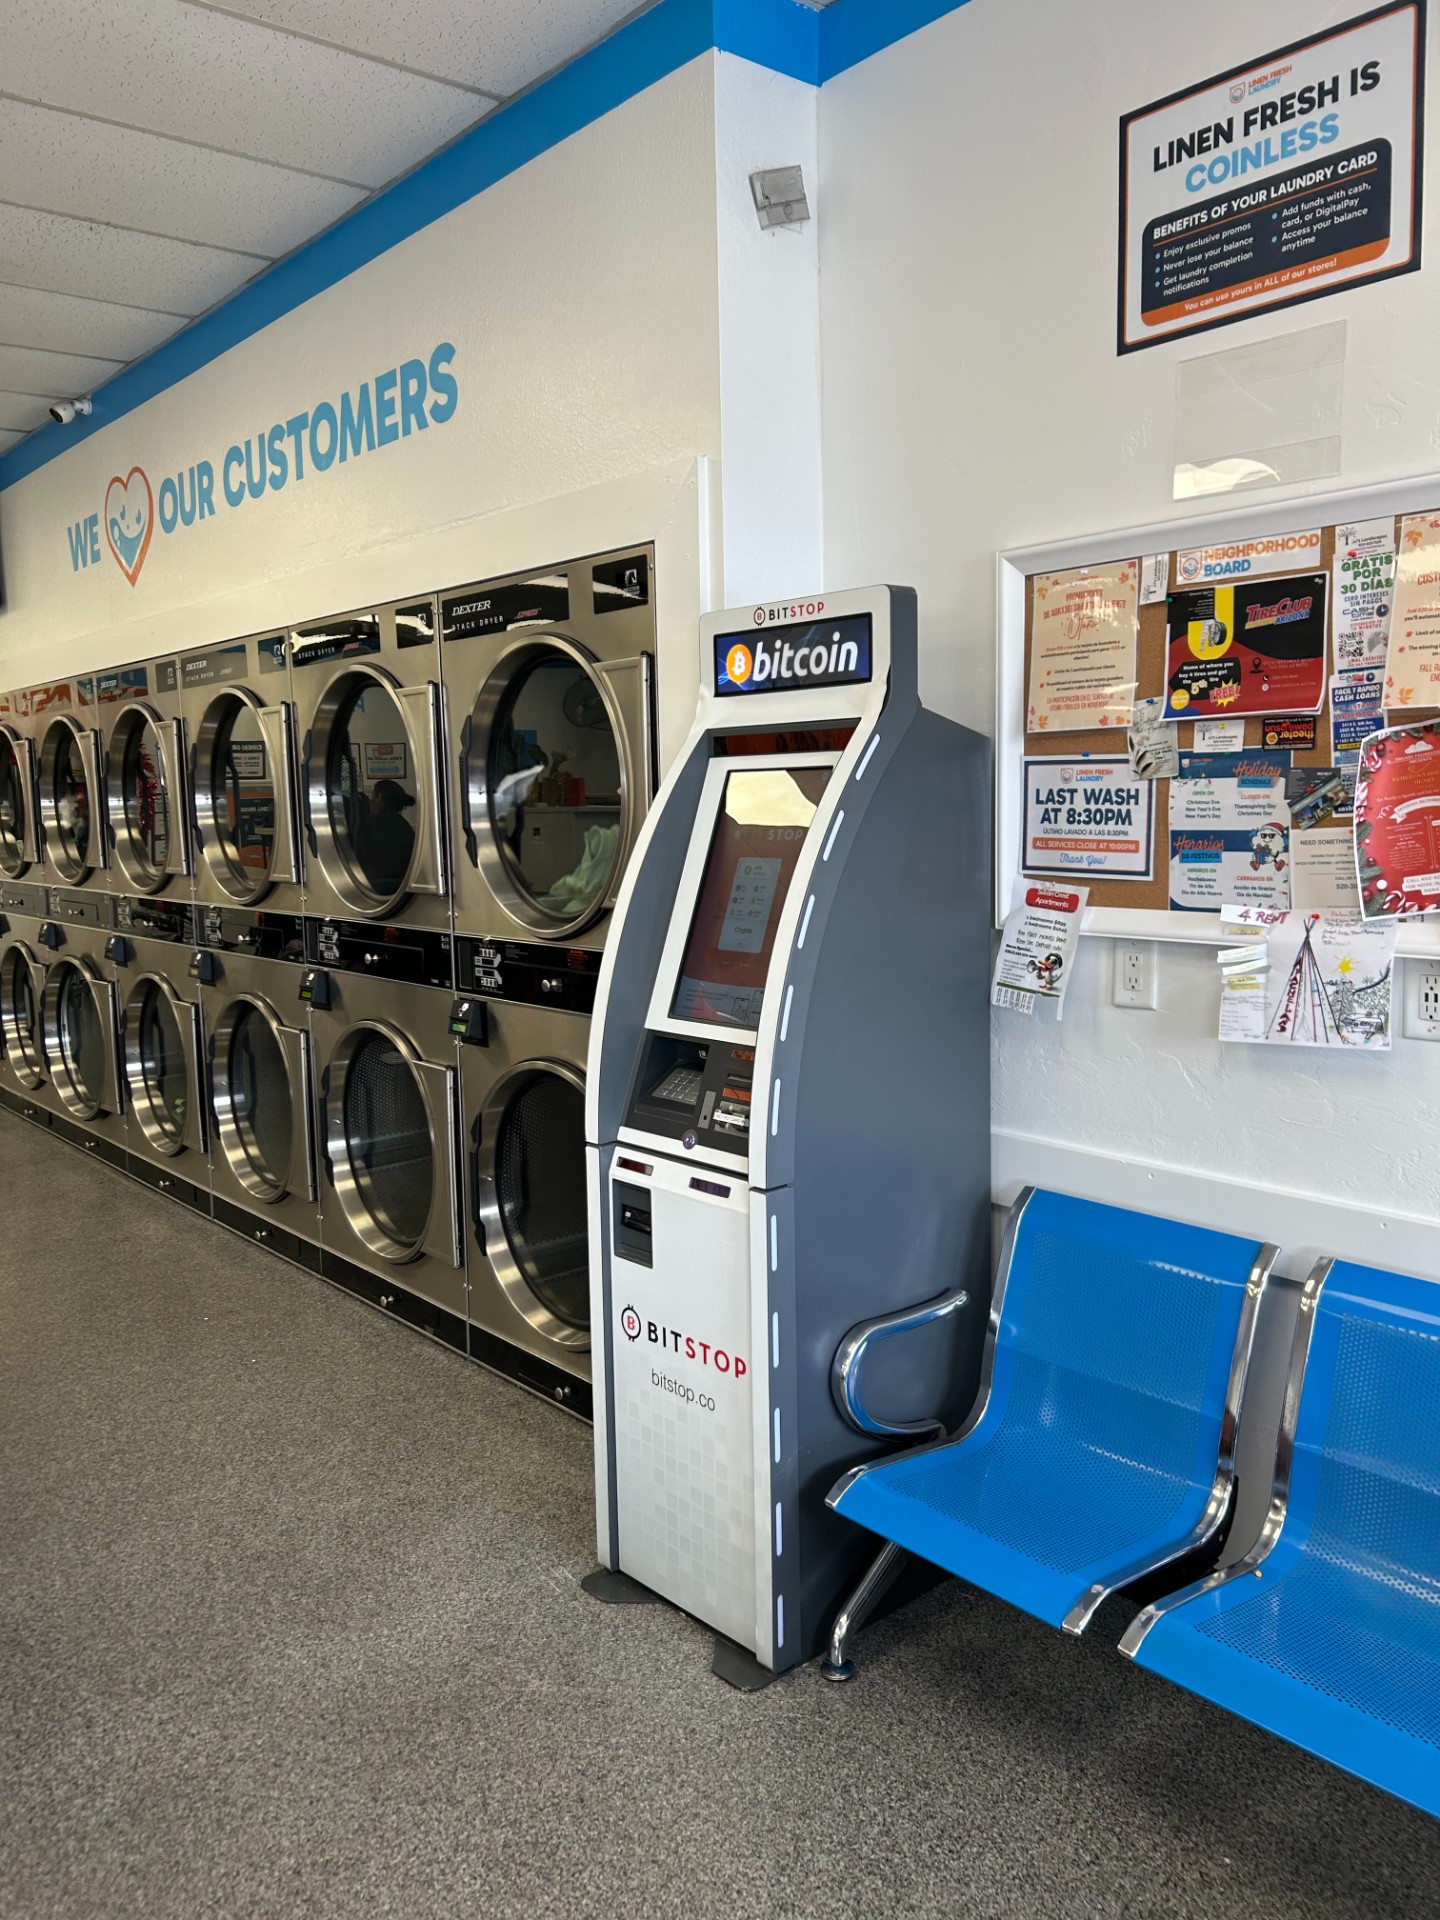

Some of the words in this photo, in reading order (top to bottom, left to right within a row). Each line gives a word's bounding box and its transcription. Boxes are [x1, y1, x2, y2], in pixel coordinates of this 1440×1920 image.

[1248, 73, 1269, 88] LINEN
[1270, 64, 1292, 81] FRESH
[1248, 77, 1281, 95] LAUNDRY
[1153, 117, 1234, 172] LINEN
[1243, 75, 1339, 137] FRESH
[1350, 60, 1380, 96] IS
[1185, 113, 1340, 192] COINLESS
[1153, 210, 1208, 239] BENEFITS
[1211, 203, 1228, 218] OF
[1231, 189, 1267, 212] YOUR
[1270, 165, 1334, 198] LAUNDRY
[1337, 151, 1378, 174] CARD
[1282, 205, 1299, 217] Add
[1301, 197, 1324, 212] funds
[1326, 189, 1346, 202] with
[1347, 182, 1371, 195] cash,
[1281, 216, 1302, 228] card,
[1304, 213, 1314, 221] or
[1315, 198, 1360, 218] DigitalPay
[1281, 226, 1311, 241] Access
[1312, 219, 1332, 232] your
[1333, 207, 1368, 223] balance
[1164, 243, 1184, 258] Enjoy
[1185, 233, 1220, 250] exclusive
[1222, 222, 1252, 238] promos
[1281, 235, 1316, 252] anytime
[1163, 259, 1185, 272] Never
[1187, 253, 1203, 264] lose
[1204, 248, 1222, 260] your
[1223, 237, 1254, 251] balance
[1163, 276, 1177, 286] Get
[1179, 266, 1207, 281] laundry
[1208, 251, 1253, 272] completion
[1163, 276, 1210, 296] notifications
[1184, 301, 1199, 311] You
[1200, 297, 1214, 306] can
[1215, 292, 1229, 302] use
[1231, 285, 1252, 298] yours
[1254, 281, 1263, 291] in
[1264, 278, 1279, 288] ALL
[1281, 273, 1290, 281] of
[1291, 270, 1305, 279] our
[1308, 258, 1337, 274] stores!
[67, 513, 101, 572] WE
[158, 459, 215, 534] OUR
[222, 342, 458, 507] CUSTOMERS
[1204, 533, 1320, 562] NEIGHBORHOOD
[1204, 559, 1251, 577] BOARD
[1341, 554, 1393, 572] GRATIS
[1353, 567, 1381, 580] POR
[1340, 583, 1356, 594] 30
[1360, 577, 1393, 591] DÍAS
[1344, 594, 1358, 602] CERO
[1360, 590, 1388, 600] INTERESES
[1362, 597, 1382, 606] PAGOS
[451, 600, 491, 617] DEXTER
[768, 601, 824, 620] BITSTOP
[1274, 609, 1310, 625] ARIZONA
[479, 615, 504, 628] DRYER
[318, 646, 335, 656] DRYER
[752, 631, 858, 681] bitcoin
[186, 660, 208, 671] DEXTER
[1420, 664, 1432, 672] FALL
[1191, 679, 1208, 695] 5th
[1334, 687, 1351, 696] FACIL
[1357, 684, 1380, 693] RAPIDO
[1334, 694, 1354, 702] CASH
[1356, 691, 1380, 700] LOANS
[1232, 760, 1282, 778] Holiday
[1035, 788, 1078, 805] LAST
[1083, 788, 1139, 806] WASH
[1040, 808, 1062, 825] AT
[1066, 808, 1132, 826] 8:30PM
[1043, 826, 1063, 835] ÚLTIMO
[1064, 828, 1087, 836] LAVADO
[1106, 829, 1129, 837] 8:30PM
[1035, 840, 1046, 848] ALL
[1047, 841, 1075, 849] SERVICES
[1108, 842, 1136, 850] 10:00PM
[1173, 834, 1224, 851] Horarios
[1060, 852, 1084, 864] Thank
[1085, 854, 1107, 867] You!
[1035, 897, 1069, 908] Apartments
[1237, 909, 1251, 922] 4
[1256, 911, 1290, 924] RENT
[734, 926, 753, 936] Crypto
[647, 1320, 747, 1378] BITSTOP
[651, 1368, 716, 1412] bitstop.co
